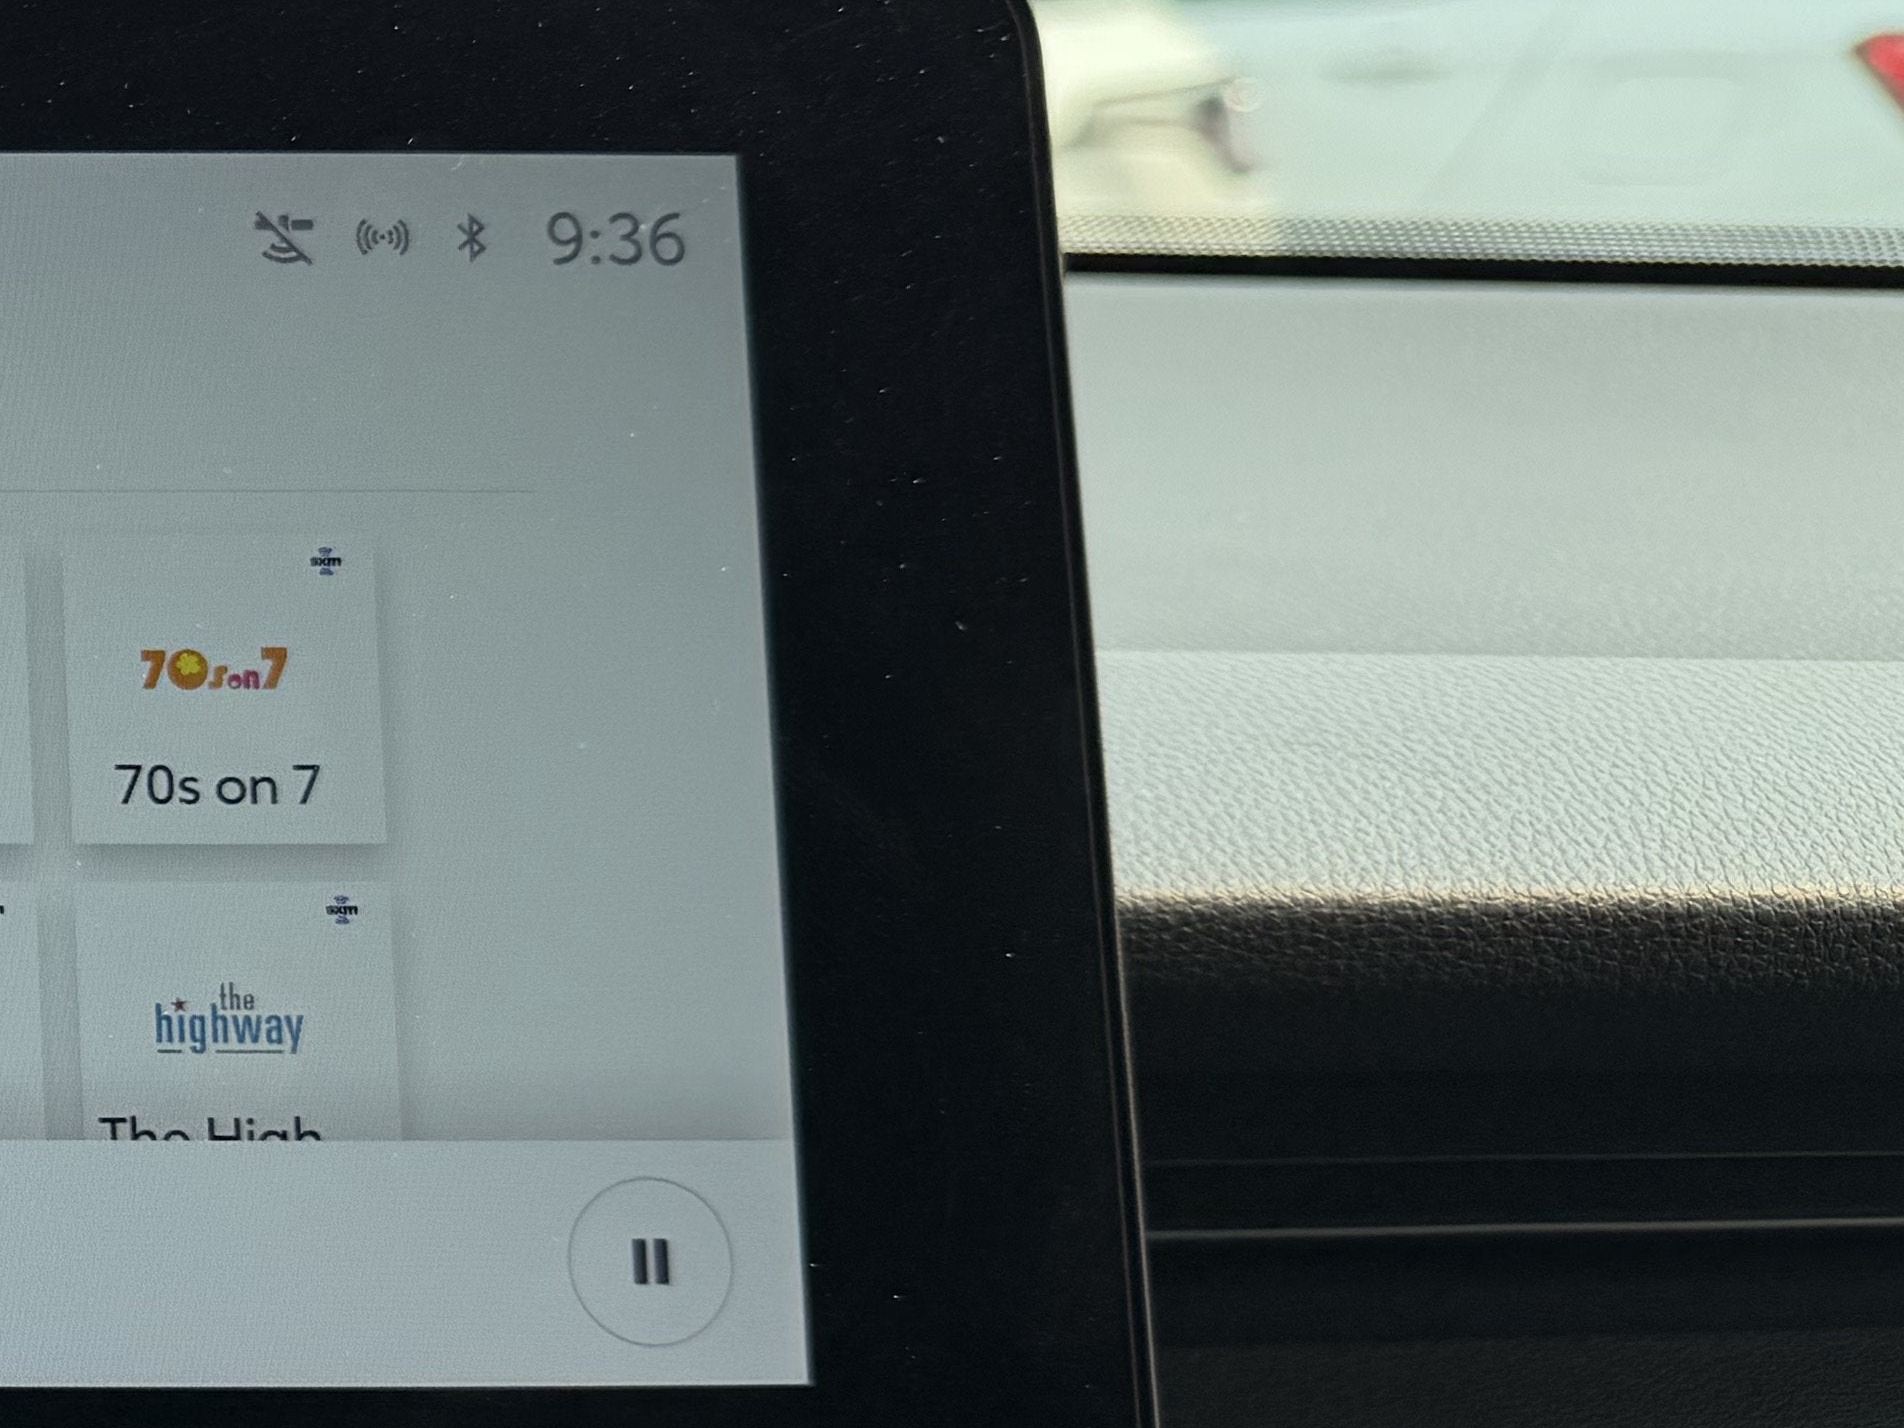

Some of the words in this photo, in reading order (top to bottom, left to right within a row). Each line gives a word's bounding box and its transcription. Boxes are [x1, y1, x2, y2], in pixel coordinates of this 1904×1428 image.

[548, 212, 686, 266] 9:36
[115, 764, 200, 805] 70s
[216, 777, 278, 805] on
[293, 764, 320, 804] 7
[220, 982, 255, 1010] the
[155, 1002, 304, 1054] highway
